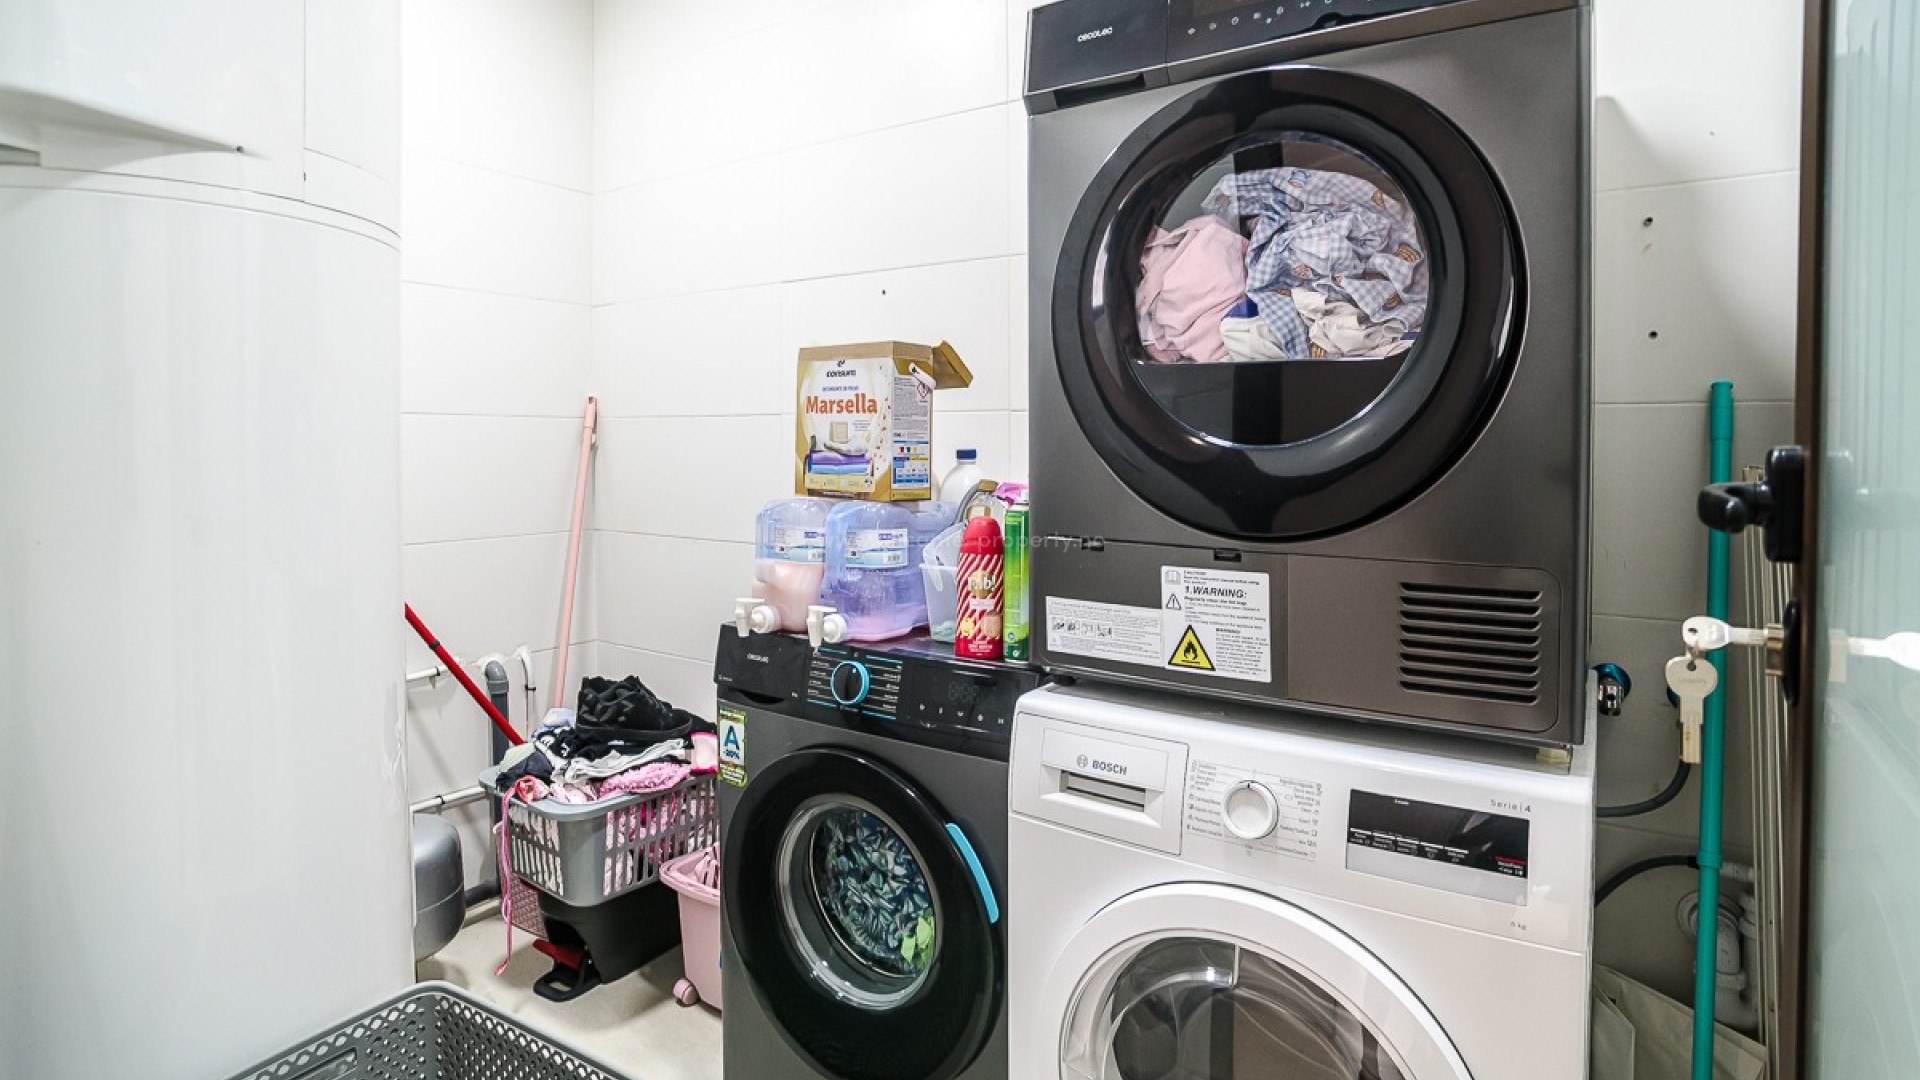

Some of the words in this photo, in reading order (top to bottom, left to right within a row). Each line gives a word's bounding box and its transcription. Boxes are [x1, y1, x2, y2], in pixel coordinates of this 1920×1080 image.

[805, 393, 878, 414] Marsella
[723, 725, 740, 750] A
[1092, 759, 1128, 776] BOSCH
